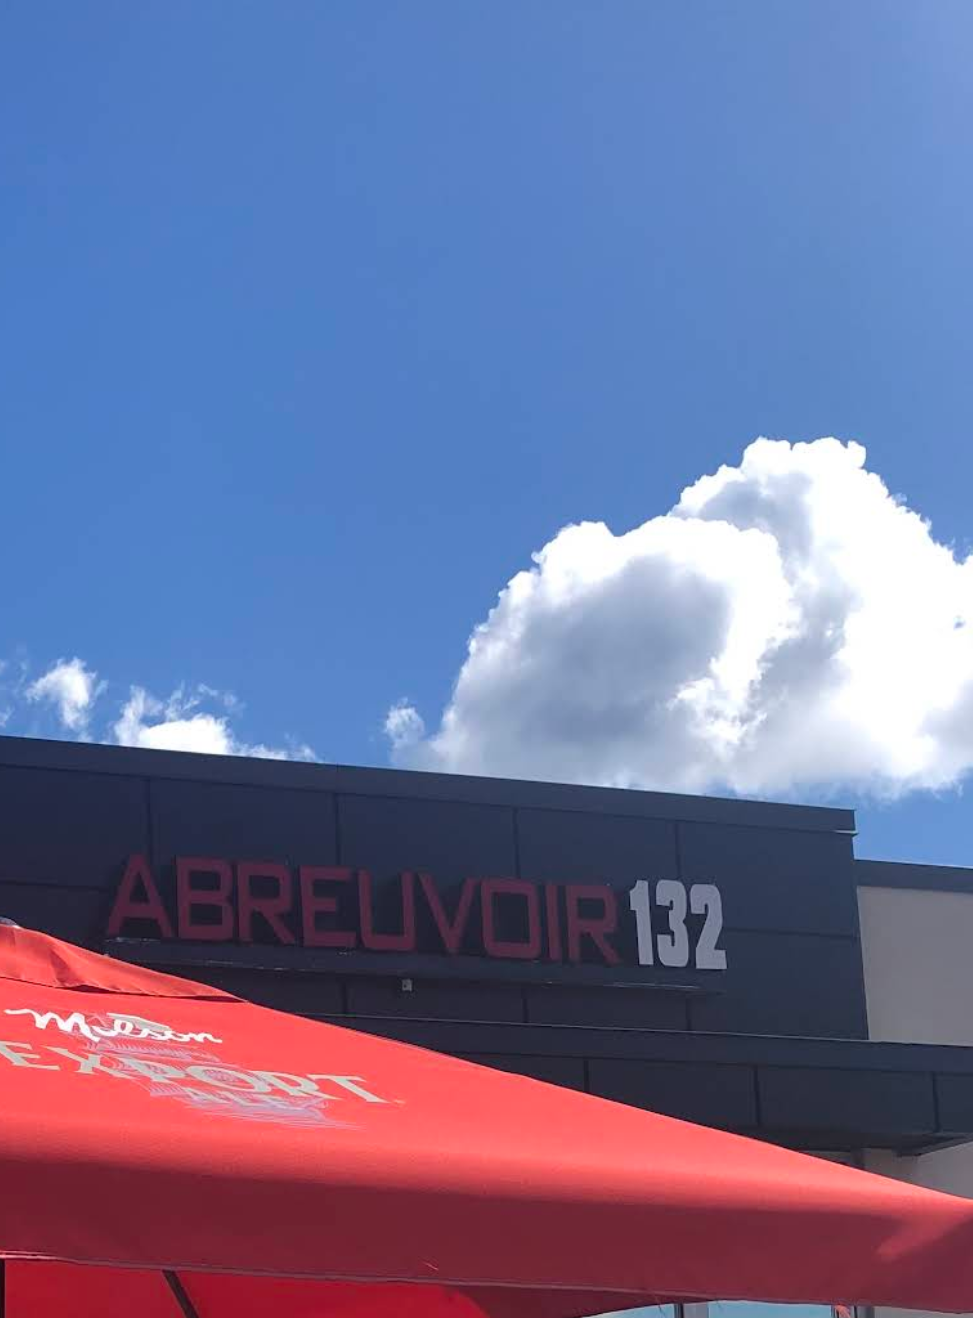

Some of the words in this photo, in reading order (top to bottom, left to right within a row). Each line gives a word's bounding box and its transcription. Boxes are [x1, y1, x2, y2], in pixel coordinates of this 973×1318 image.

[106, 853, 623, 966] ABREUVOIR
[628, 878, 728, 970] 132
[4, 1008, 223, 1043] Molson
